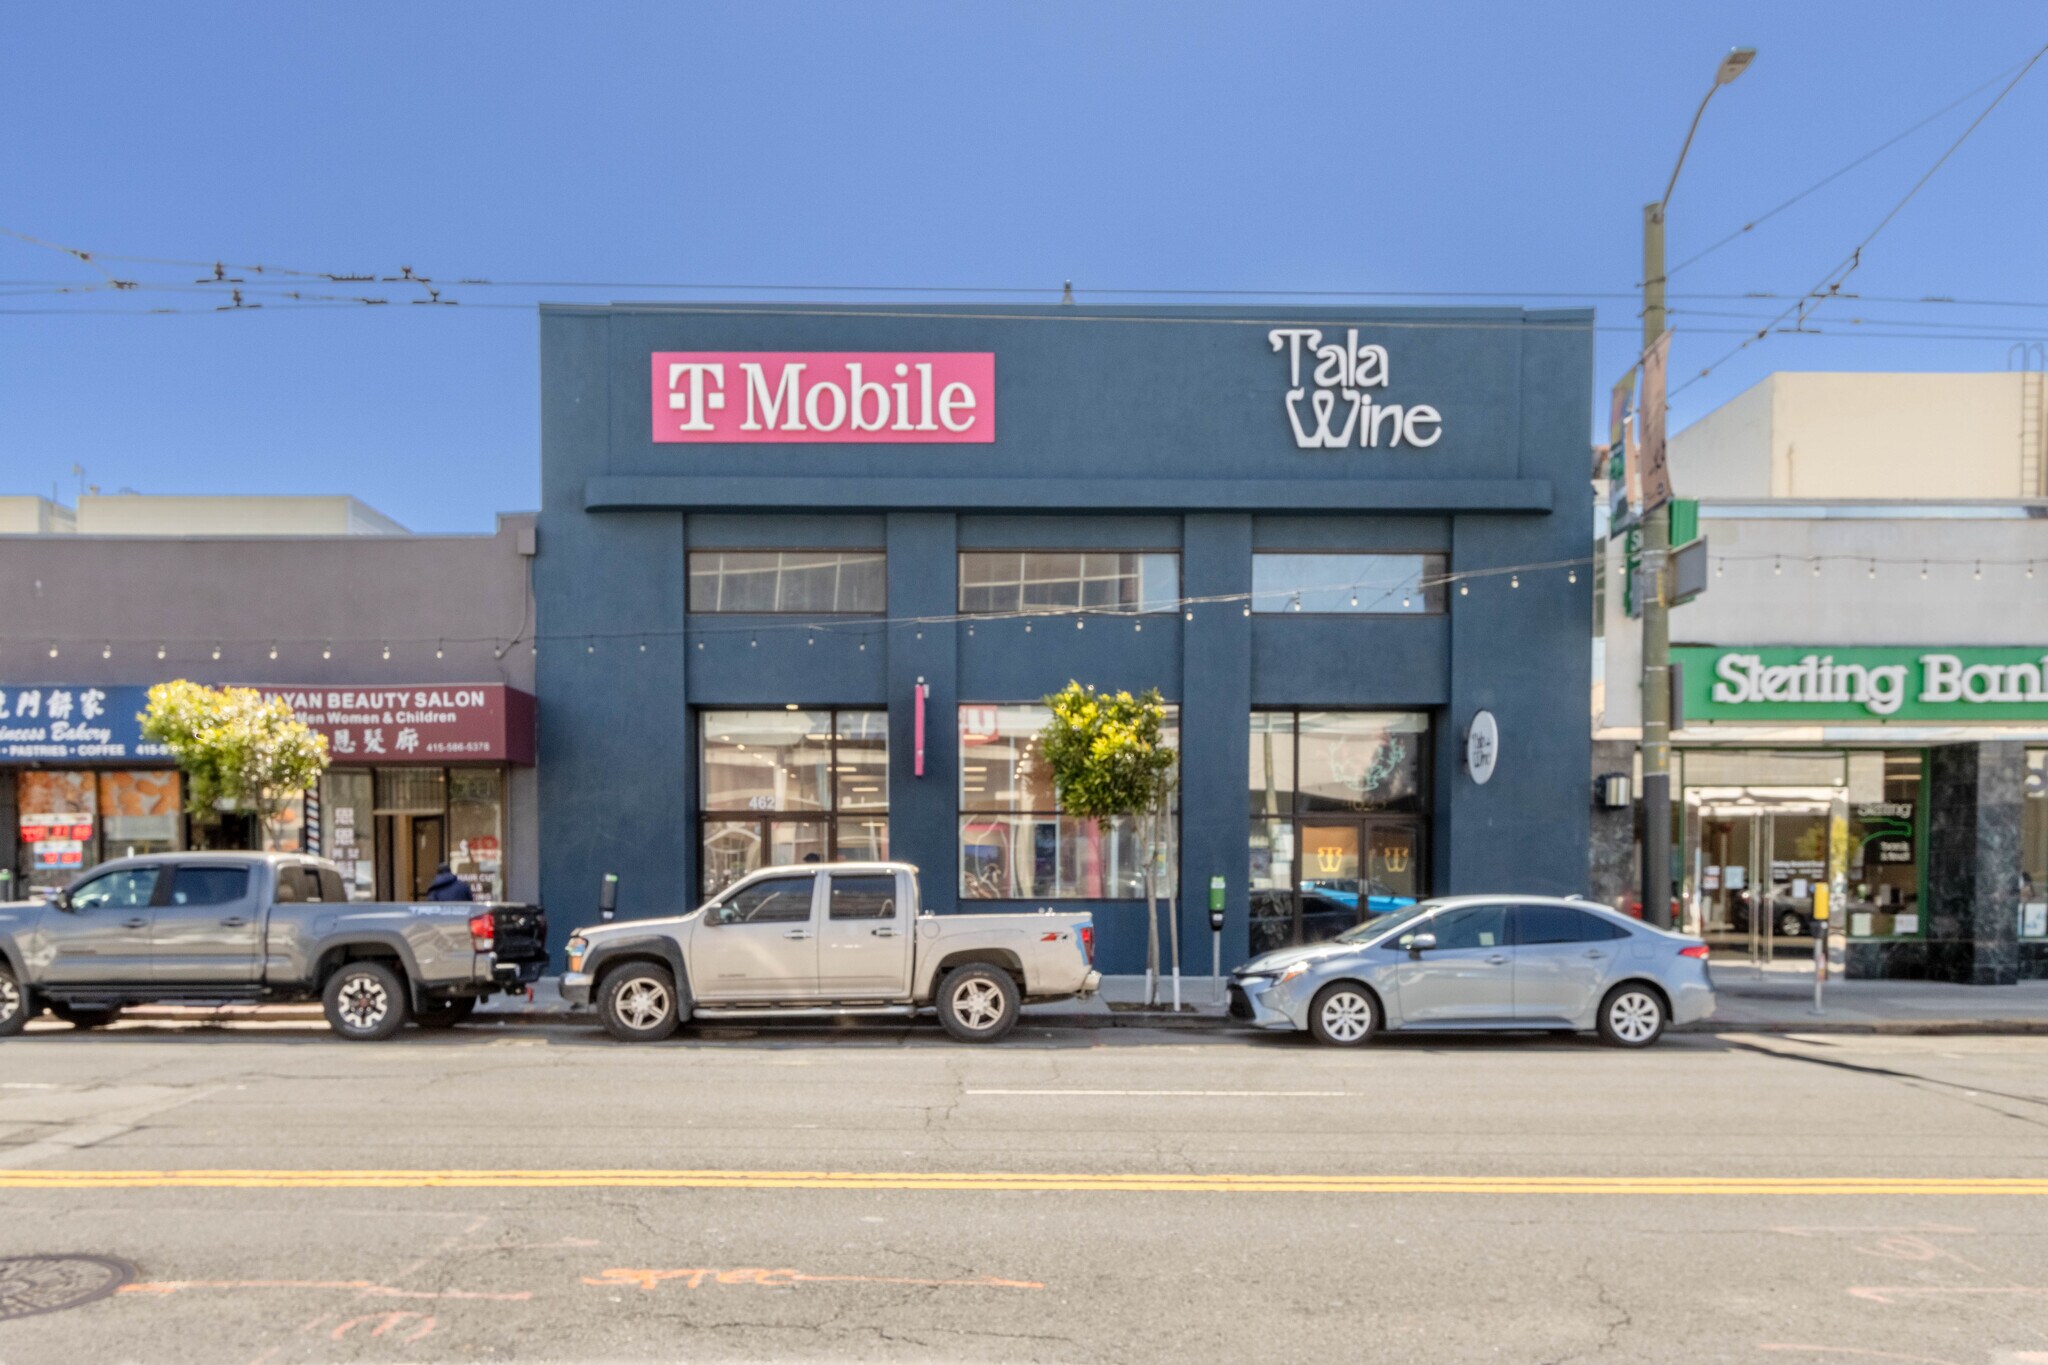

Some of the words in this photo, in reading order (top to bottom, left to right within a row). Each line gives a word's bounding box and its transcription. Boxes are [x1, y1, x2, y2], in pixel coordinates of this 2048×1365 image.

[1268, 329, 1389, 388] Tala
[669, 363, 725, 430] T
[739, 363, 976, 432] Mobile
[1285, 388, 1442, 448] Wine
[282, 691, 323, 709] YAN
[327, 691, 411, 708] BEAUTY
[414, 690, 484, 708] SALON
[1711, 653, 1908, 715] Sterling
[51, 721, 112, 744] Bakery
[295, 711, 325, 724] Men
[327, 711, 381, 724] Women
[382, 711, 394, 724] &
[395, 710, 456, 724] Children
[9, 745, 68, 757] PASTRIES
[77, 744, 126, 756] COFFEE
